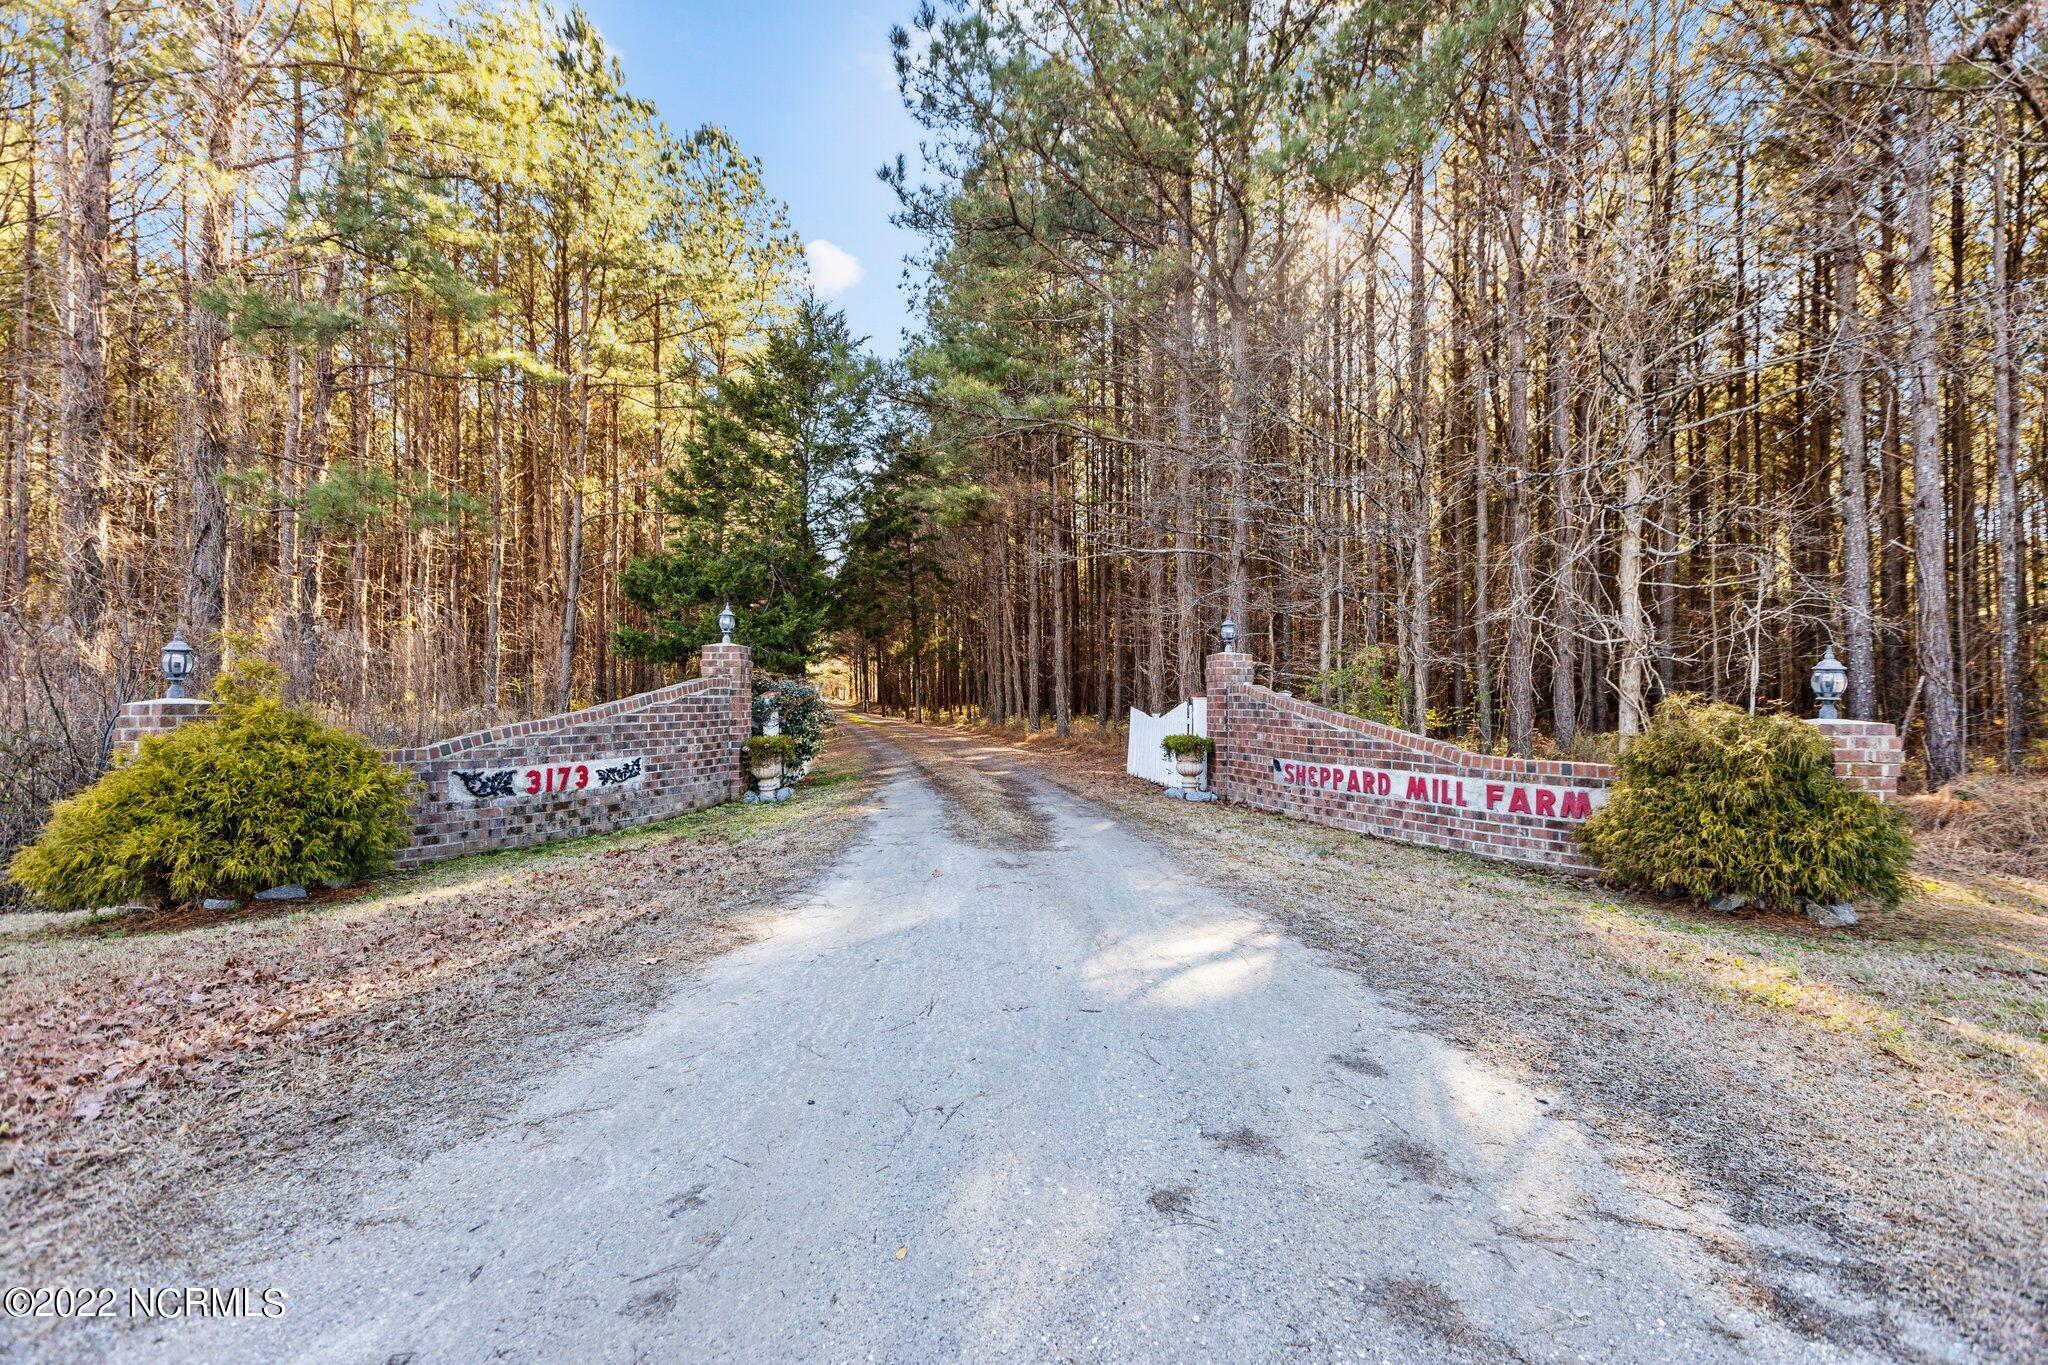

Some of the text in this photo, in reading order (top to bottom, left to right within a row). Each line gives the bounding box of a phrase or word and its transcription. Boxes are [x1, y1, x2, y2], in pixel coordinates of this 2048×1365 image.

[525, 764, 589, 795] 3173
[1284, 763, 1593, 819] SHEPPARD MILL FARM
